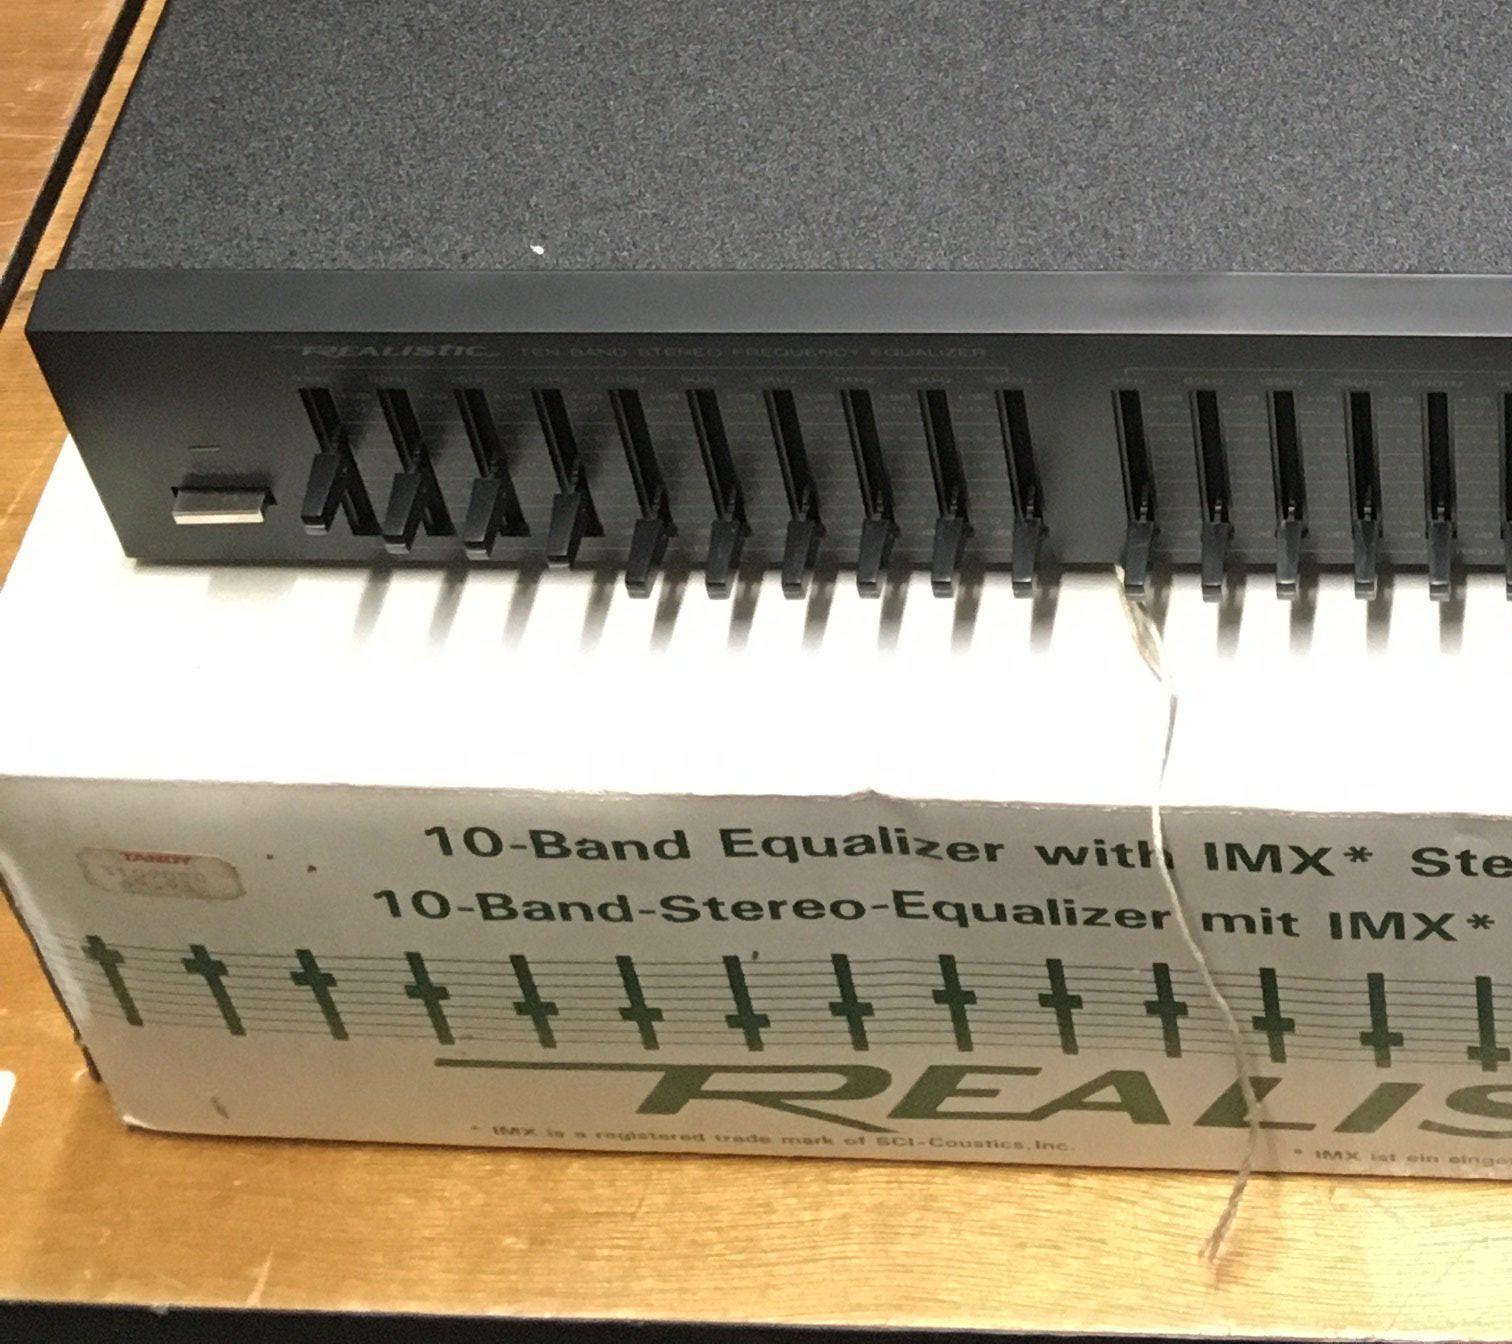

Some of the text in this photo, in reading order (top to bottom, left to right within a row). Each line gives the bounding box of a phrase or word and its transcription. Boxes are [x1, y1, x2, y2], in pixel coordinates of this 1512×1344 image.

[425, 827, 689, 862] 10-Band
[721, 827, 1004, 868] Equalizer
[1036, 838, 1173, 872] with
[373, 889, 1171, 931] 10-Band-Stereo-Equalizer
[1201, 907, 1298, 938] mit
[493, 1126, 536, 1138] IMX
[547, 1127, 568, 1139] is
[596, 1128, 704, 1147] registered
[715, 1131, 773, 1144] trade
[782, 1133, 833, 1146] mark
[845, 1134, 867, 1147] of
[1315, 1149, 1359, 1162] IMX
